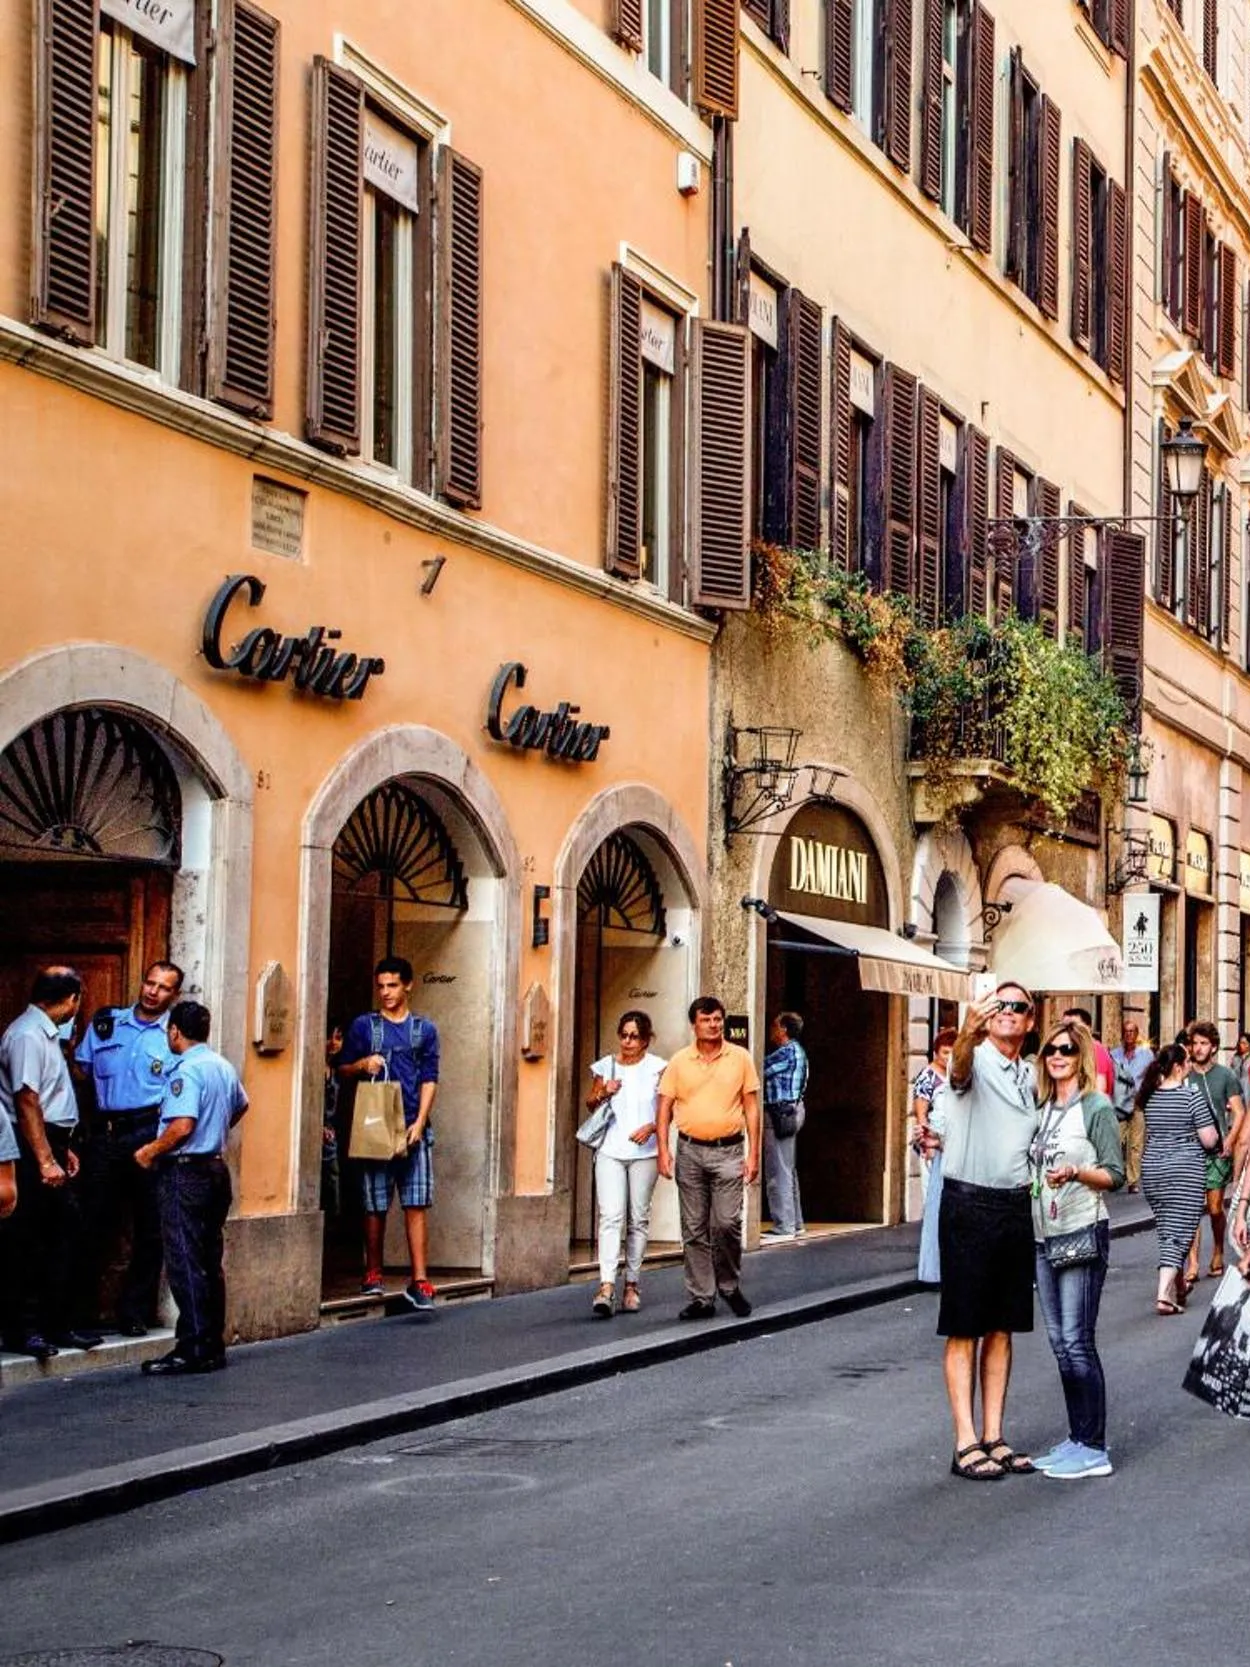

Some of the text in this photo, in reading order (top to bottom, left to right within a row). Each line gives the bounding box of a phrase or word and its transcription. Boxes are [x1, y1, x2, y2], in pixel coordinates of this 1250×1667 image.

[364, 140, 404, 180] artier
[200, 574, 387, 701] Cartier
[485, 661, 611, 763] Cartier
[789, 836, 869, 904] DAMIANI
